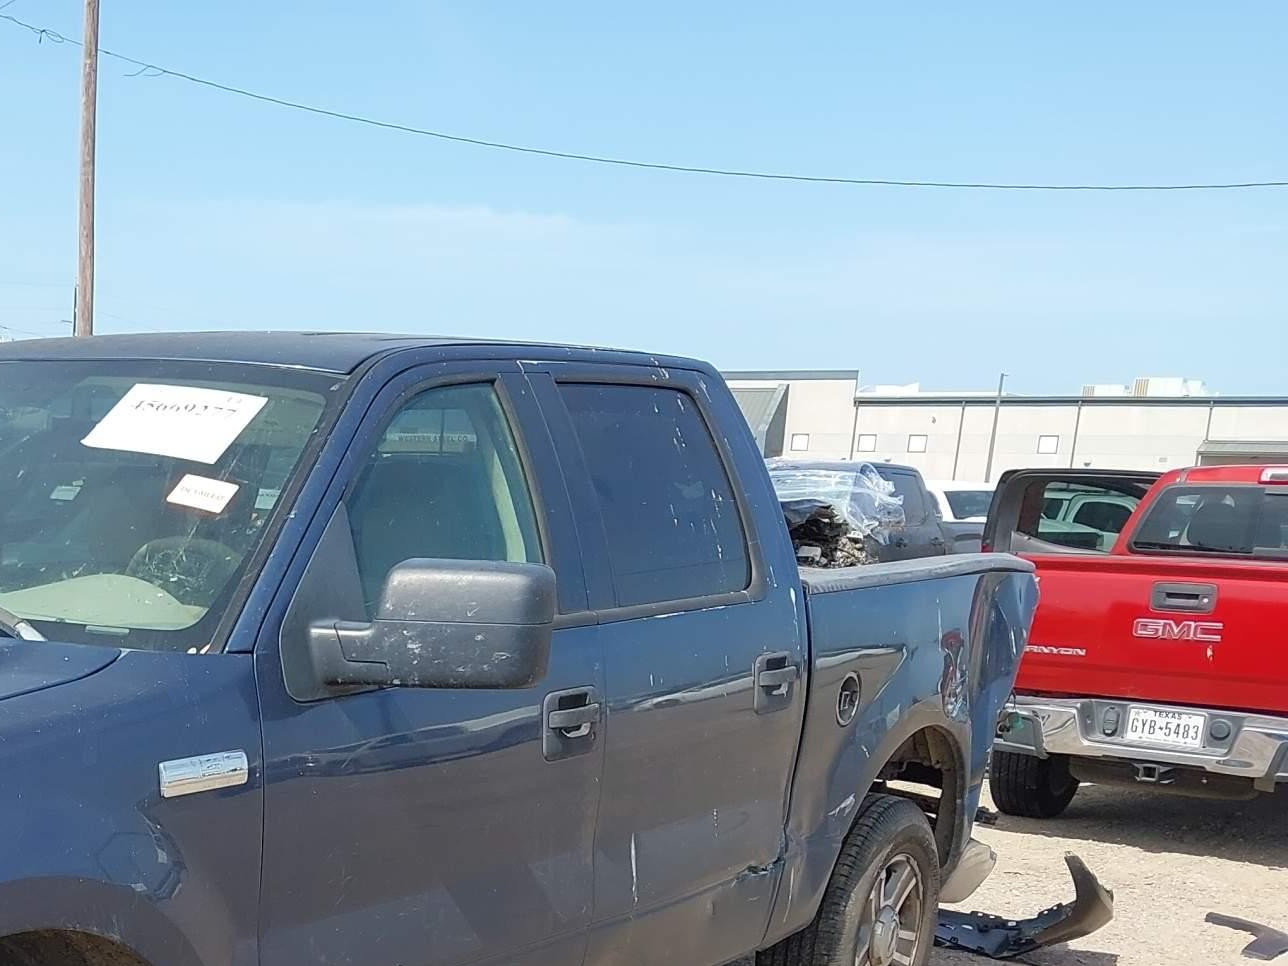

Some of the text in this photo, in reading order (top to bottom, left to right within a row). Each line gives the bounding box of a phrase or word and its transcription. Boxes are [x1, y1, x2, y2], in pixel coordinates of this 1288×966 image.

[1132, 618, 1224, 642] GMC
[1024, 645, 1087, 656] ANYON
[1153, 710, 1183, 720] TEXAS
